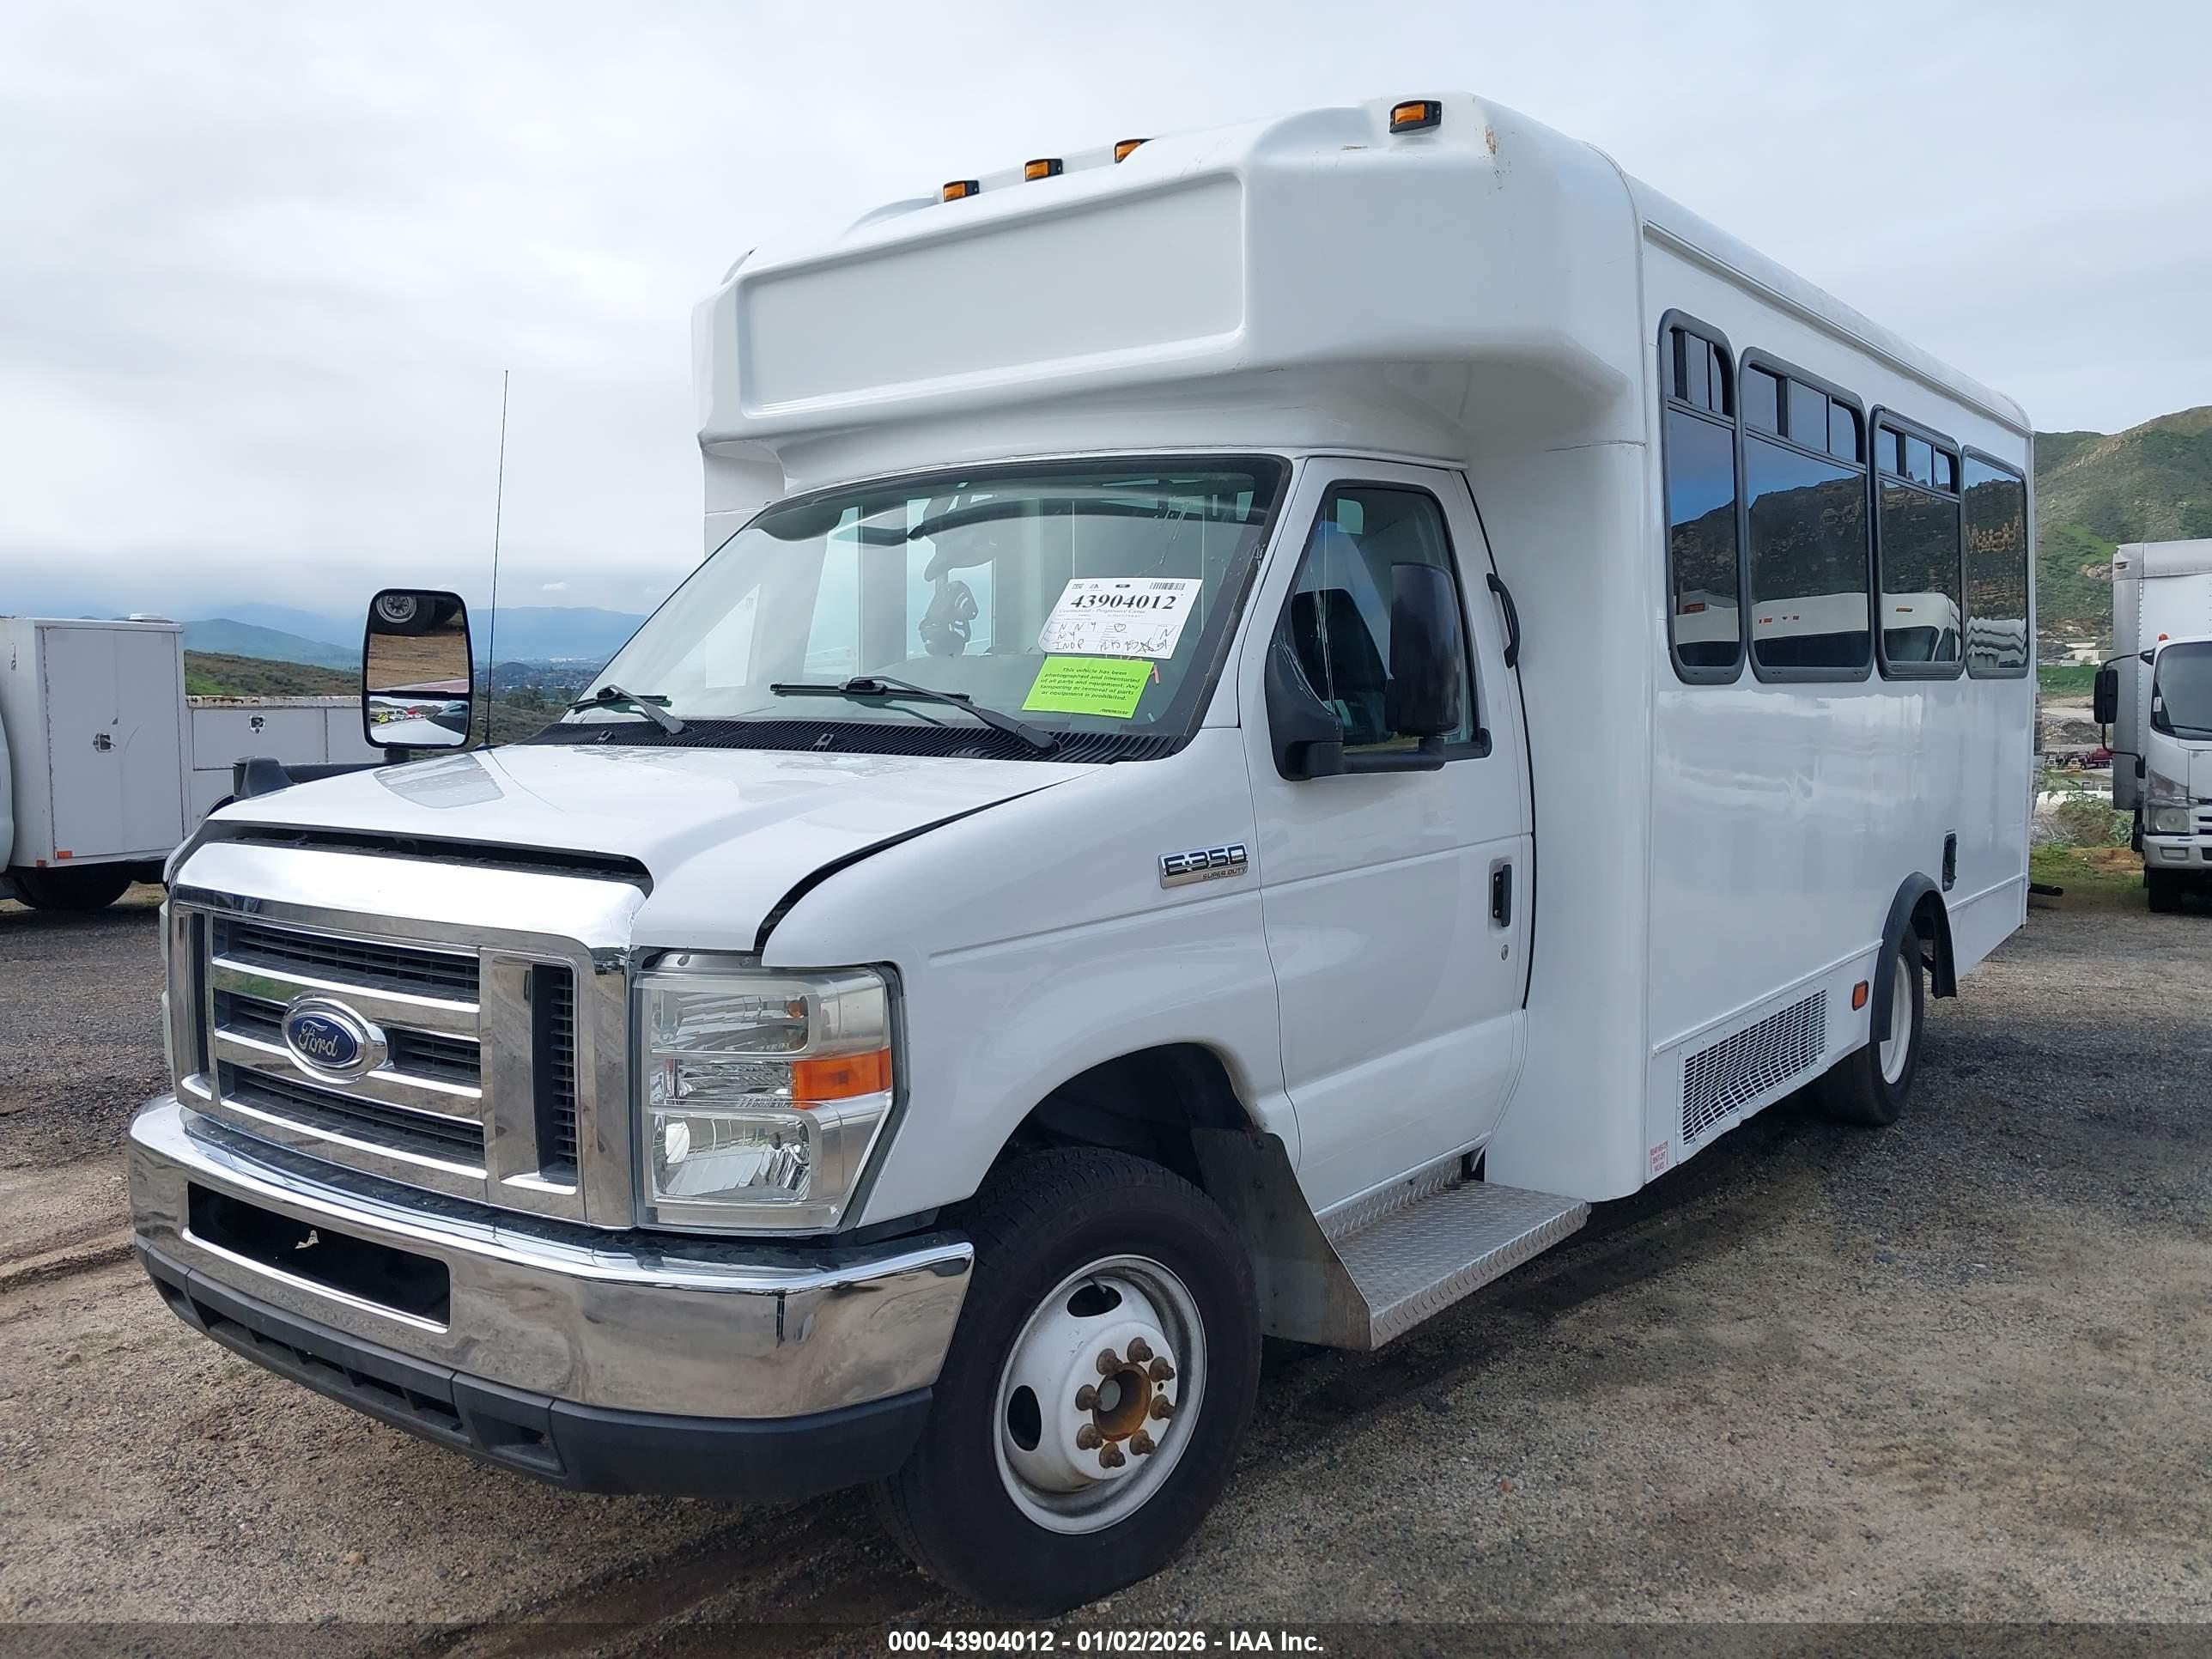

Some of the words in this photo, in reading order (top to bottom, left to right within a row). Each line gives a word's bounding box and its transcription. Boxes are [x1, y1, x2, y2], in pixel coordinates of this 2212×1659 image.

[1070, 594, 1176, 609] 43904012
[1164, 845, 1247, 877] E-350
[1202, 870, 1226, 879] SUPER
[1227, 866, 1247, 875] DUTY
[298, 1020, 338, 1057] Ford
